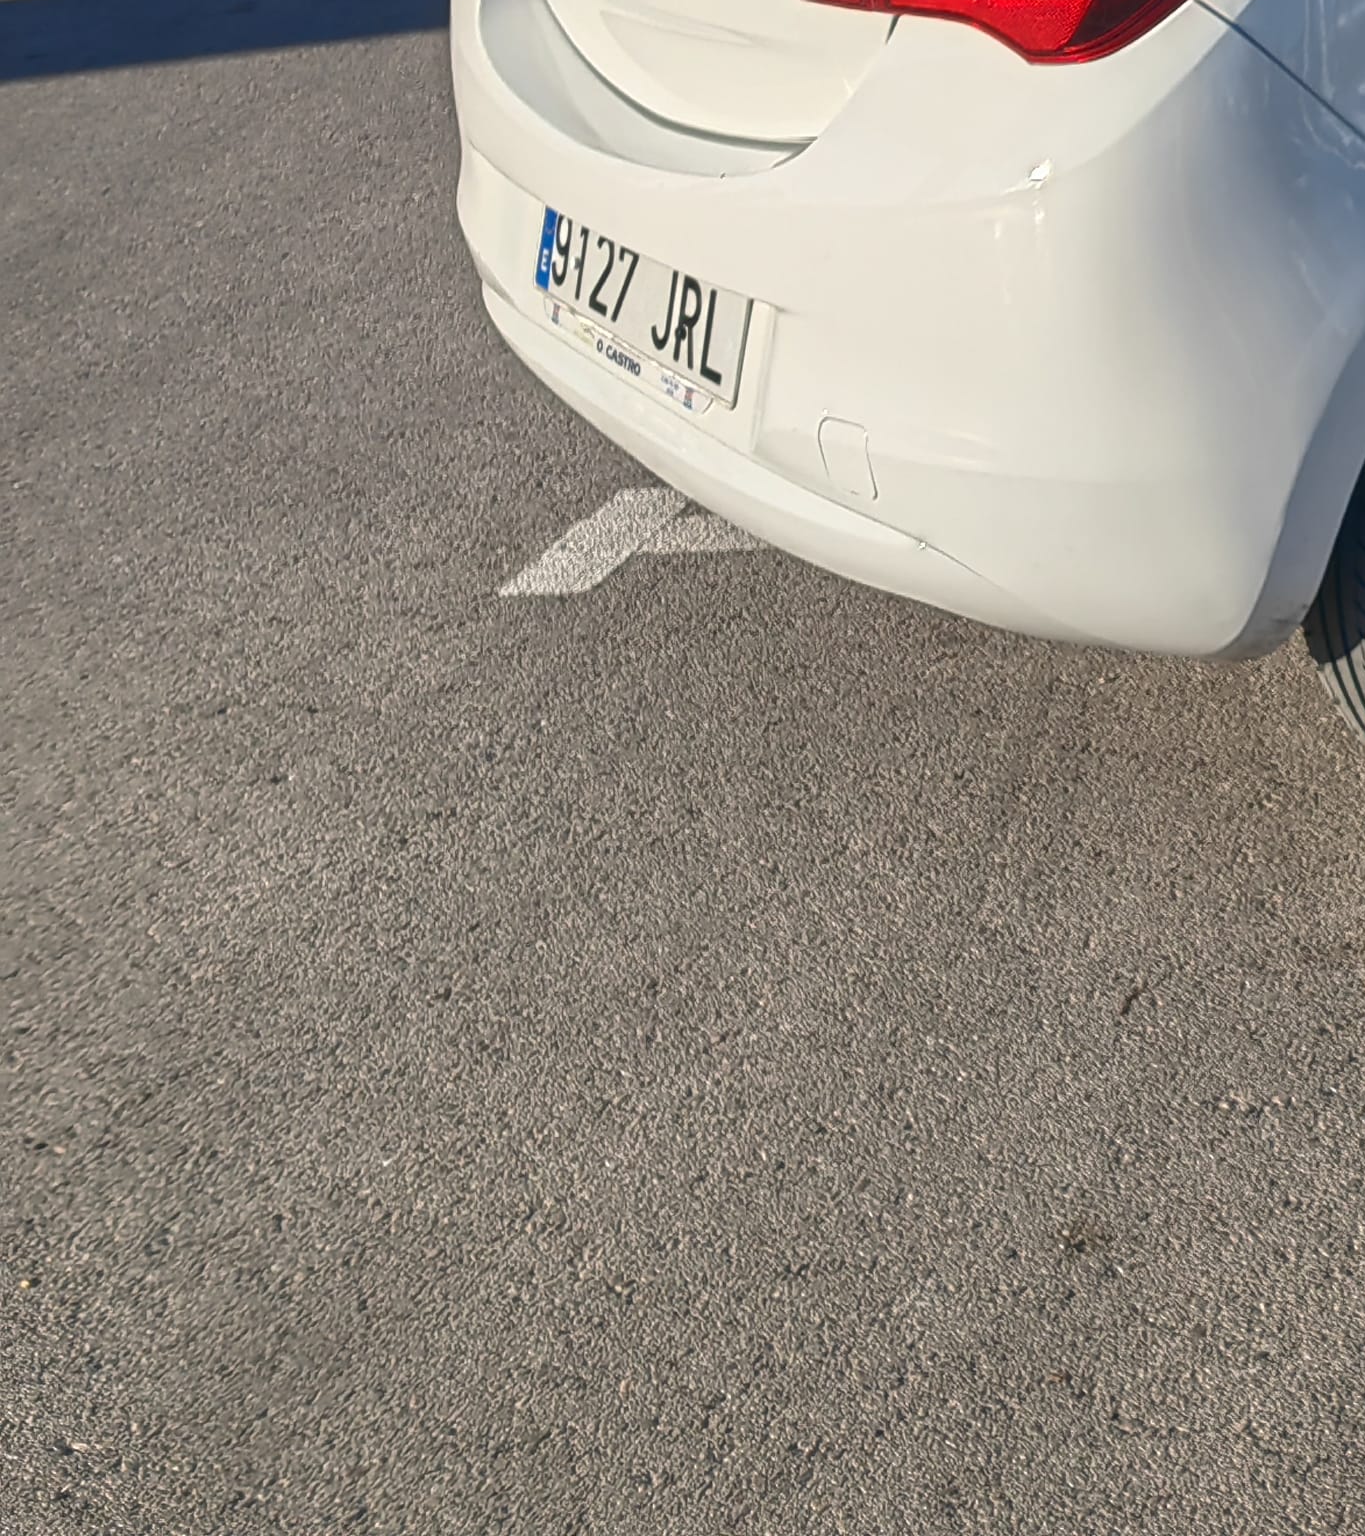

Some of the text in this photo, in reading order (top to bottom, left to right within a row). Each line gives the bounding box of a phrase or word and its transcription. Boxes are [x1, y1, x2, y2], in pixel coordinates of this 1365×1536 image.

[540, 248, 550, 272] E
[551, 214, 722, 385] 9127 JRL
[605, 345, 642, 376] CASTRO
